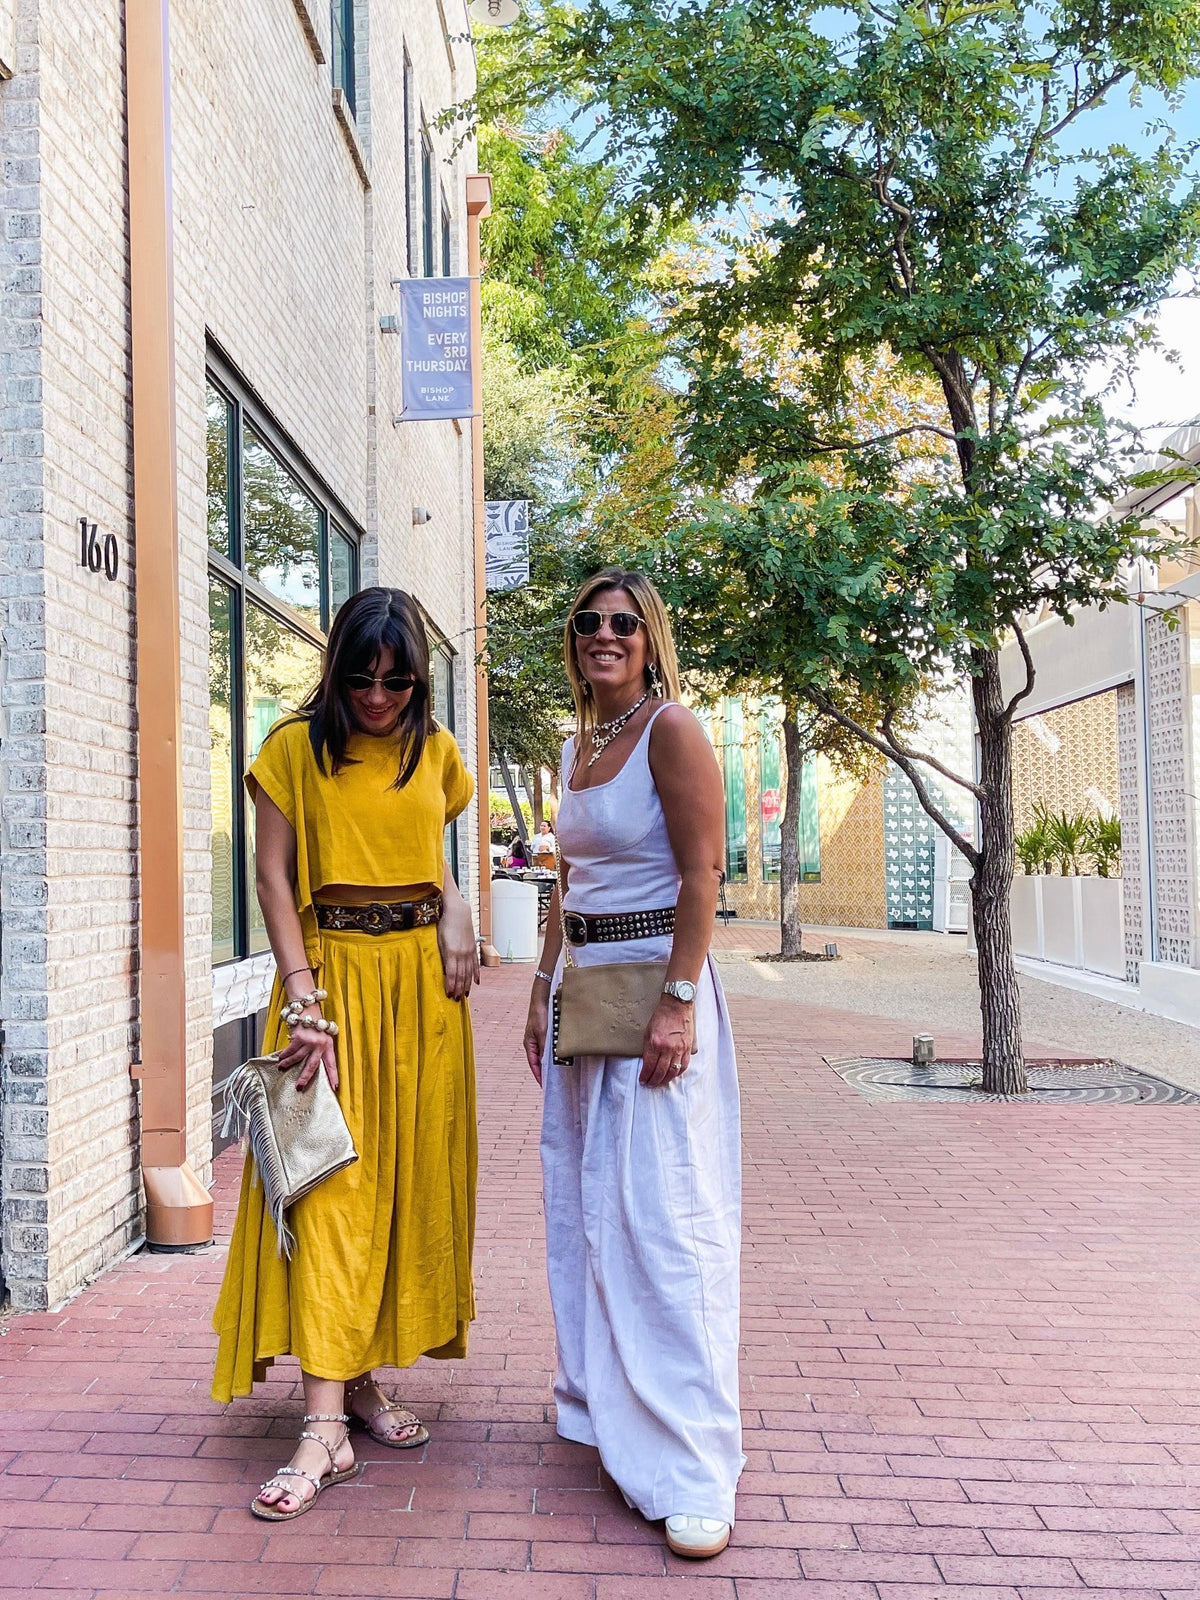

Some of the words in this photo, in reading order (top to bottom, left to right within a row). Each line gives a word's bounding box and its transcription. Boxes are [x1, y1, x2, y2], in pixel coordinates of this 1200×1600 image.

[423, 292, 466, 304] BISHOP
[423, 305, 467, 318] NIGHTS
[428, 332, 467, 345] EVERY
[444, 346, 467, 358] 3RD
[406, 359, 468, 372] THURSDAY
[420, 386, 454, 394] BISHOP
[80, 517, 119, 581] 160
